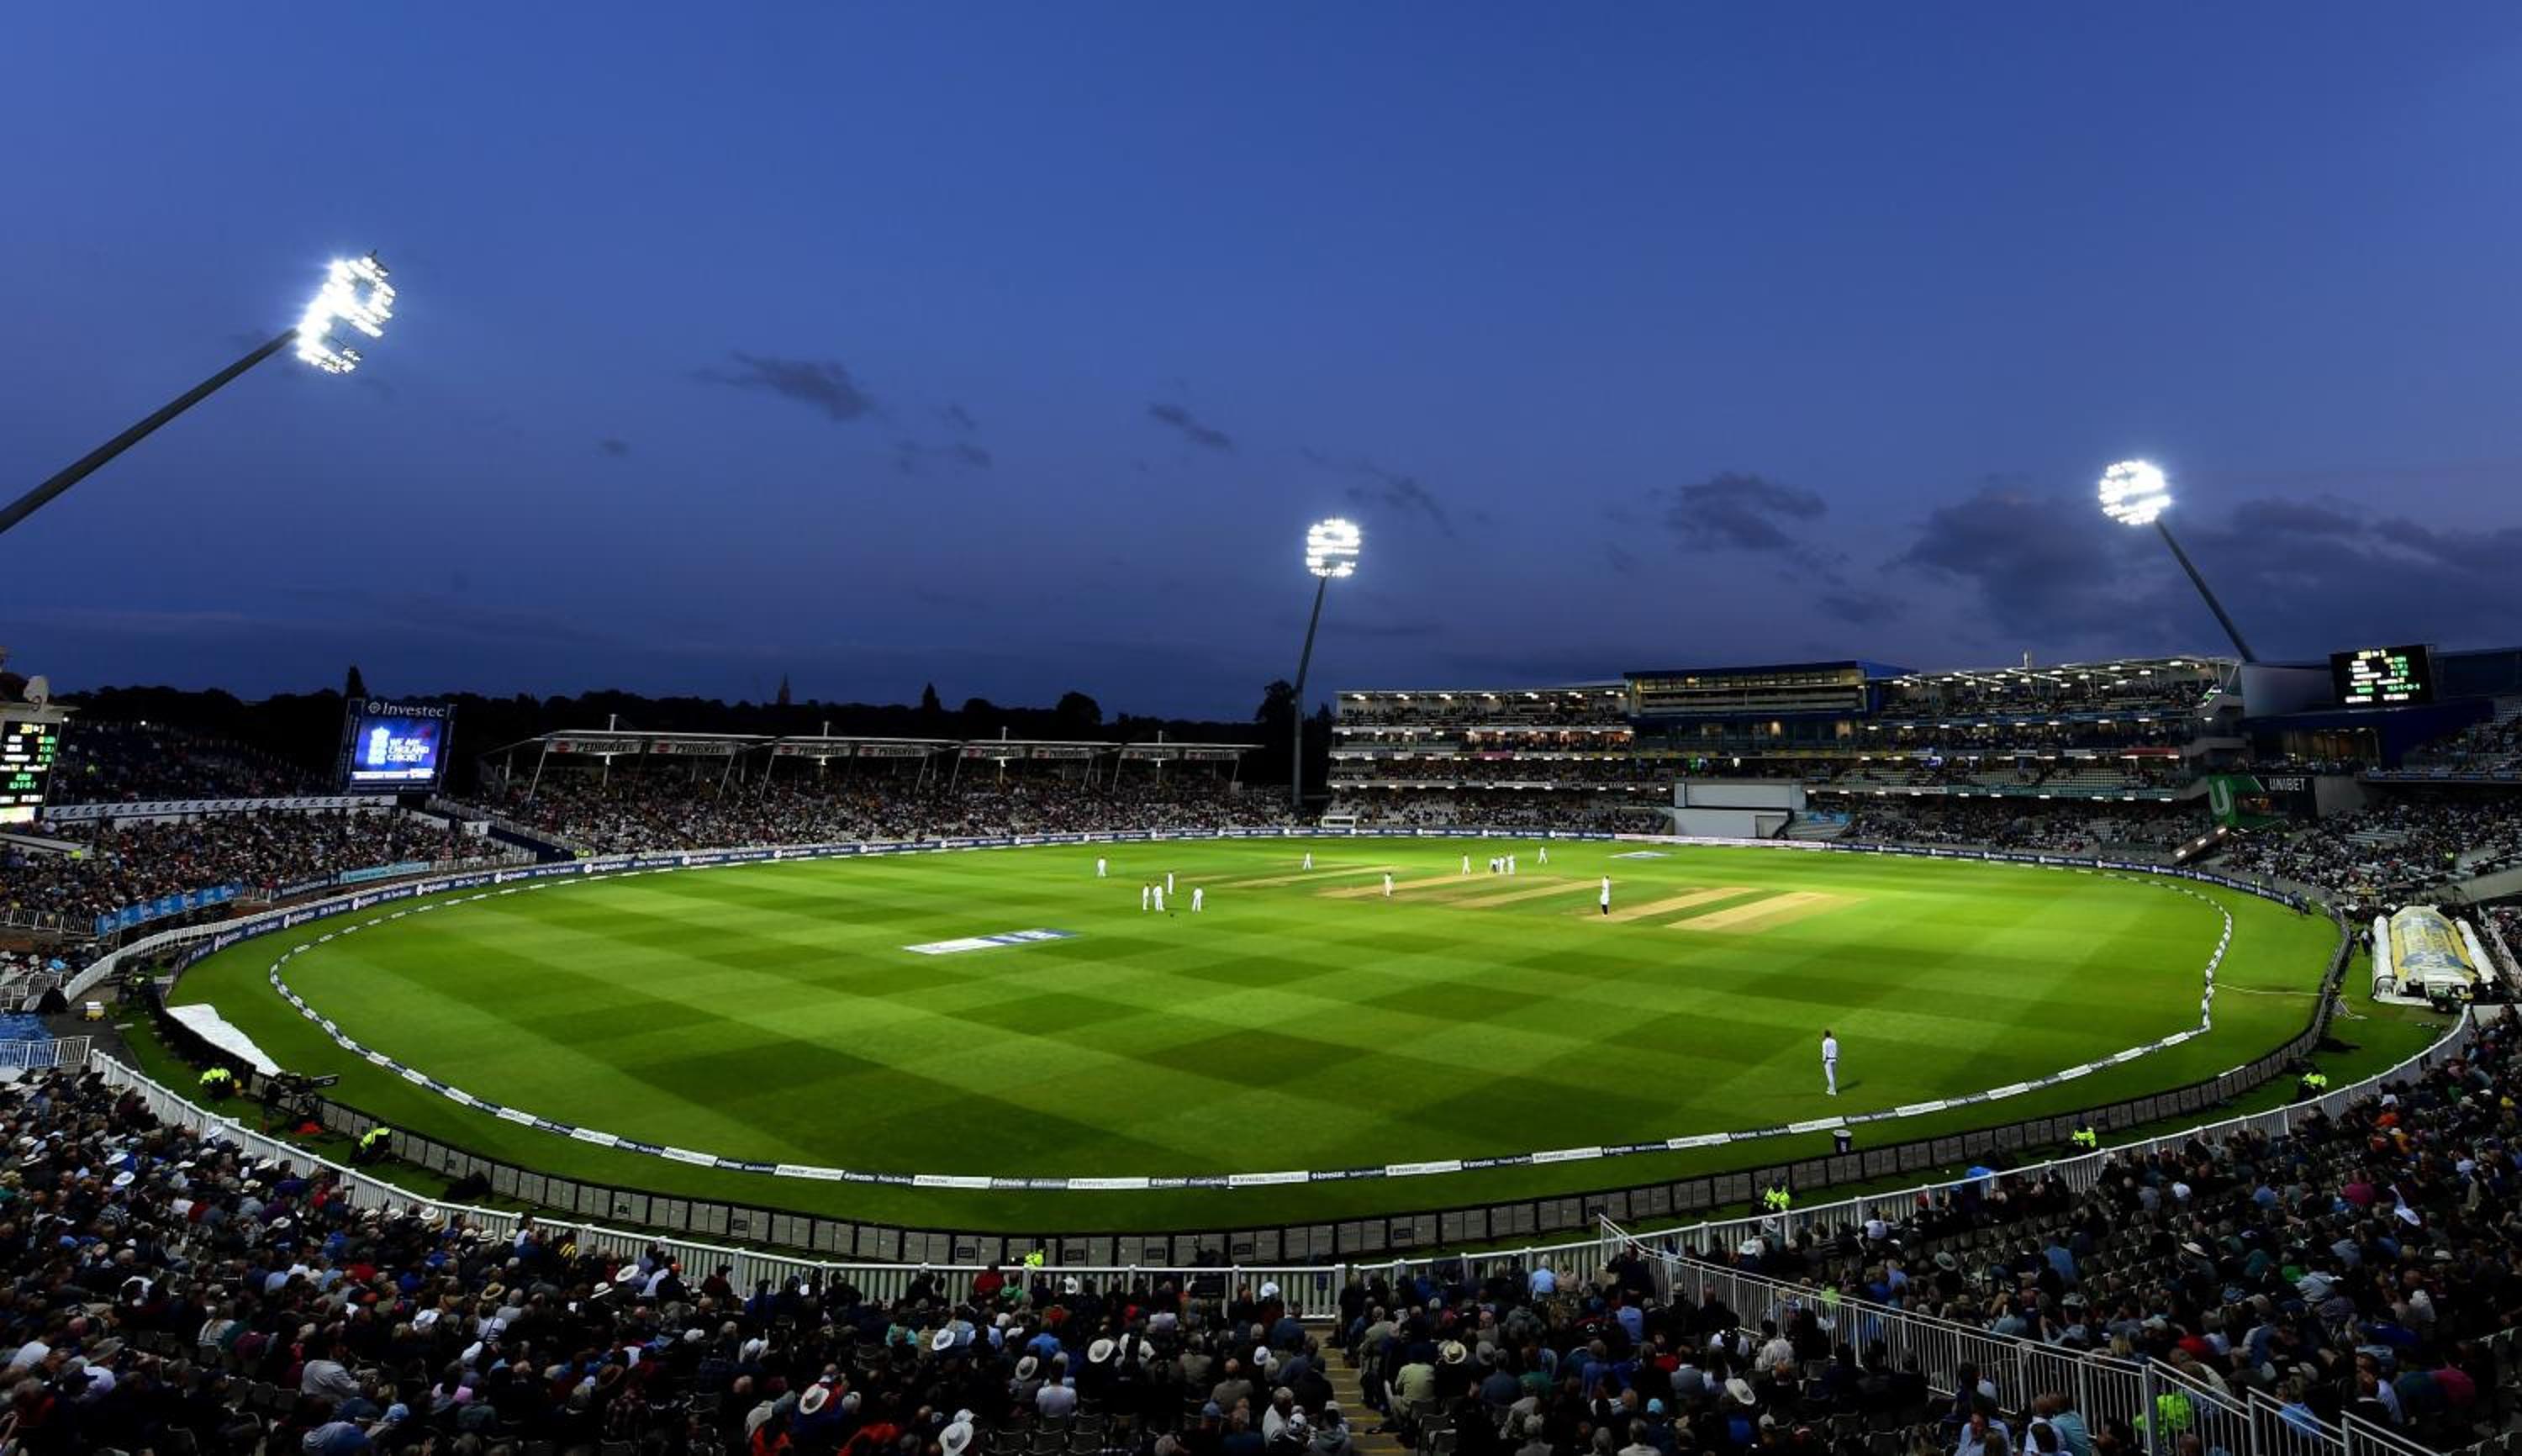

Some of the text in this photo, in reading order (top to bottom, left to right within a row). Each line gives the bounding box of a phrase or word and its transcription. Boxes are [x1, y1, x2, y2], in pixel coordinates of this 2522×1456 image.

[383, 702, 445, 717] Investec
[2269, 778, 2305, 791] UNIBET
[2209, 779, 2230, 816] U
[591, 862, 627, 871] edgbaston
